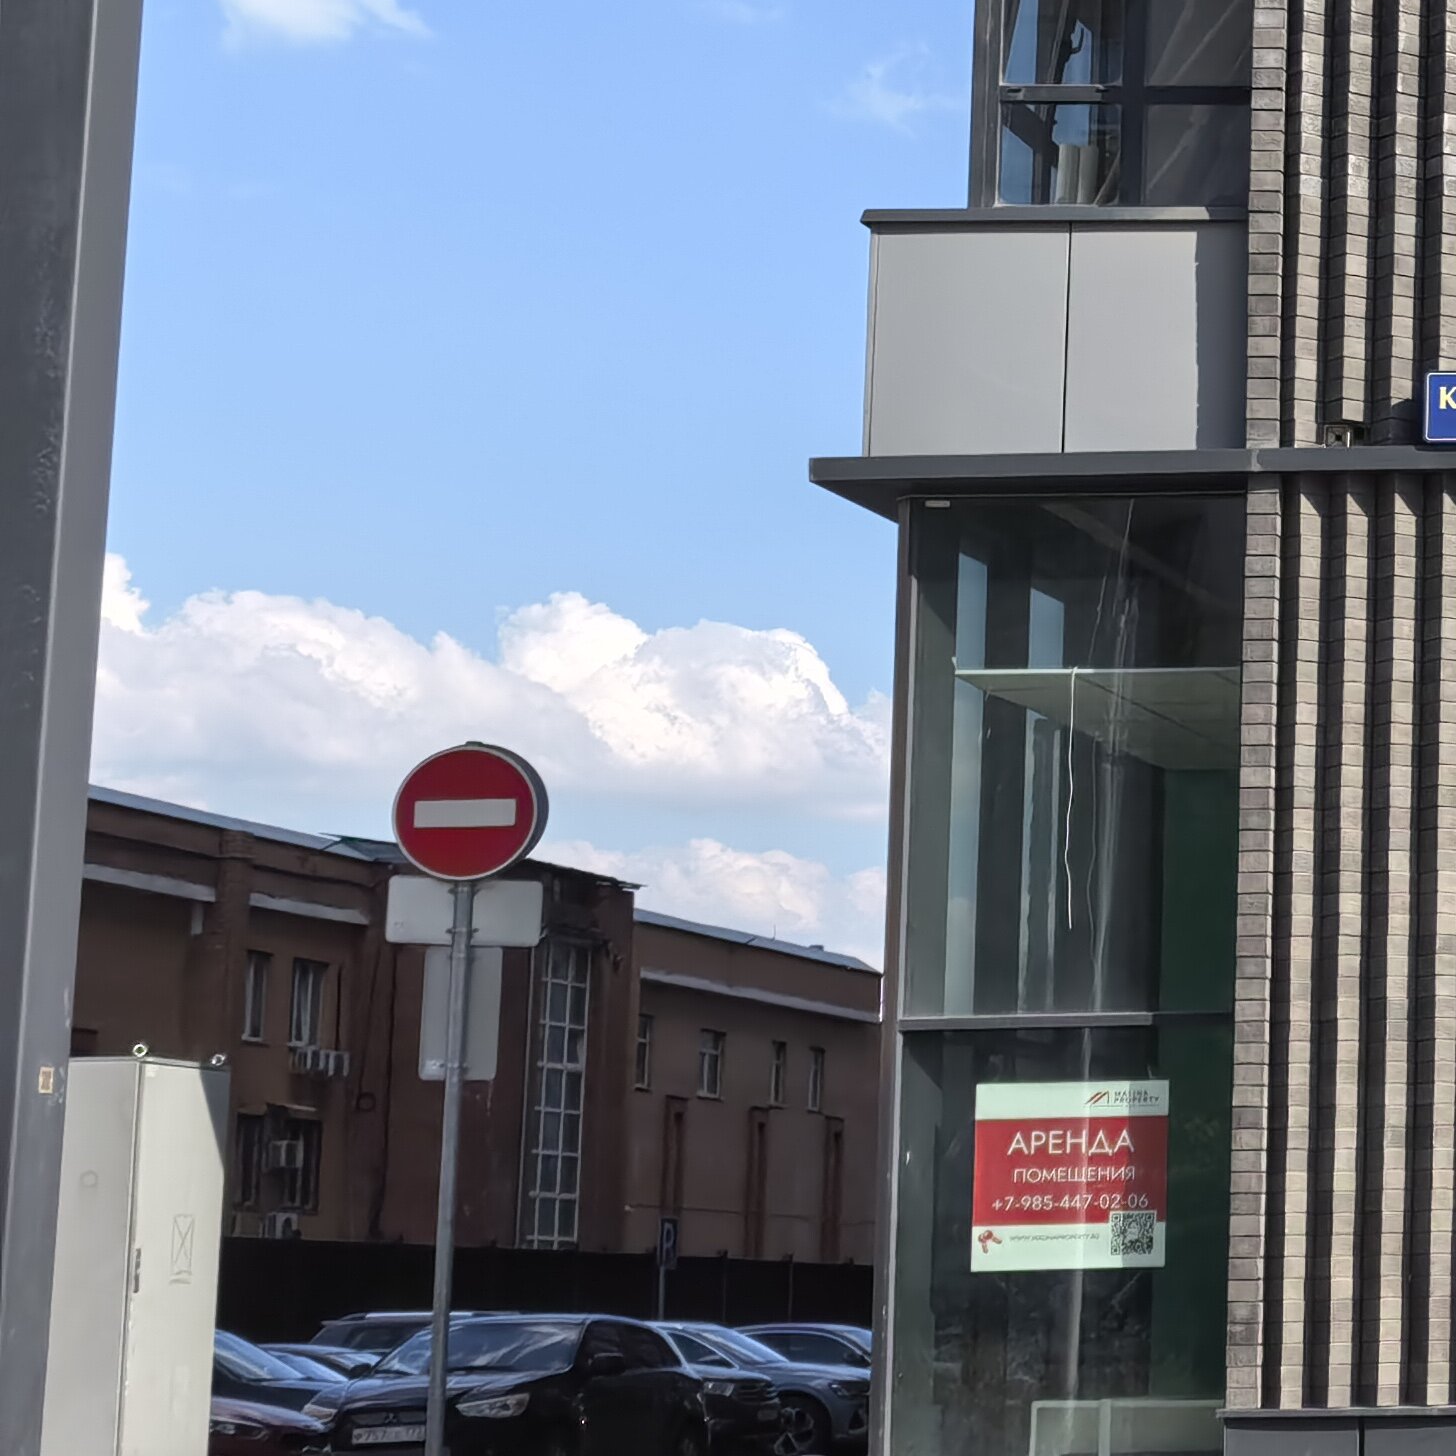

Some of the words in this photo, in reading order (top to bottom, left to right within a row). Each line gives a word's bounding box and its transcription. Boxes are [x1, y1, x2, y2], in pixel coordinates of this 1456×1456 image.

[1007, 1128, 1135, 1156] АРЕНДА
[1013, 1166, 1135, 1184] ПОМЕЩЕНИЯ
[992, 1193, 1149, 1211] +7-985-447-02-06
